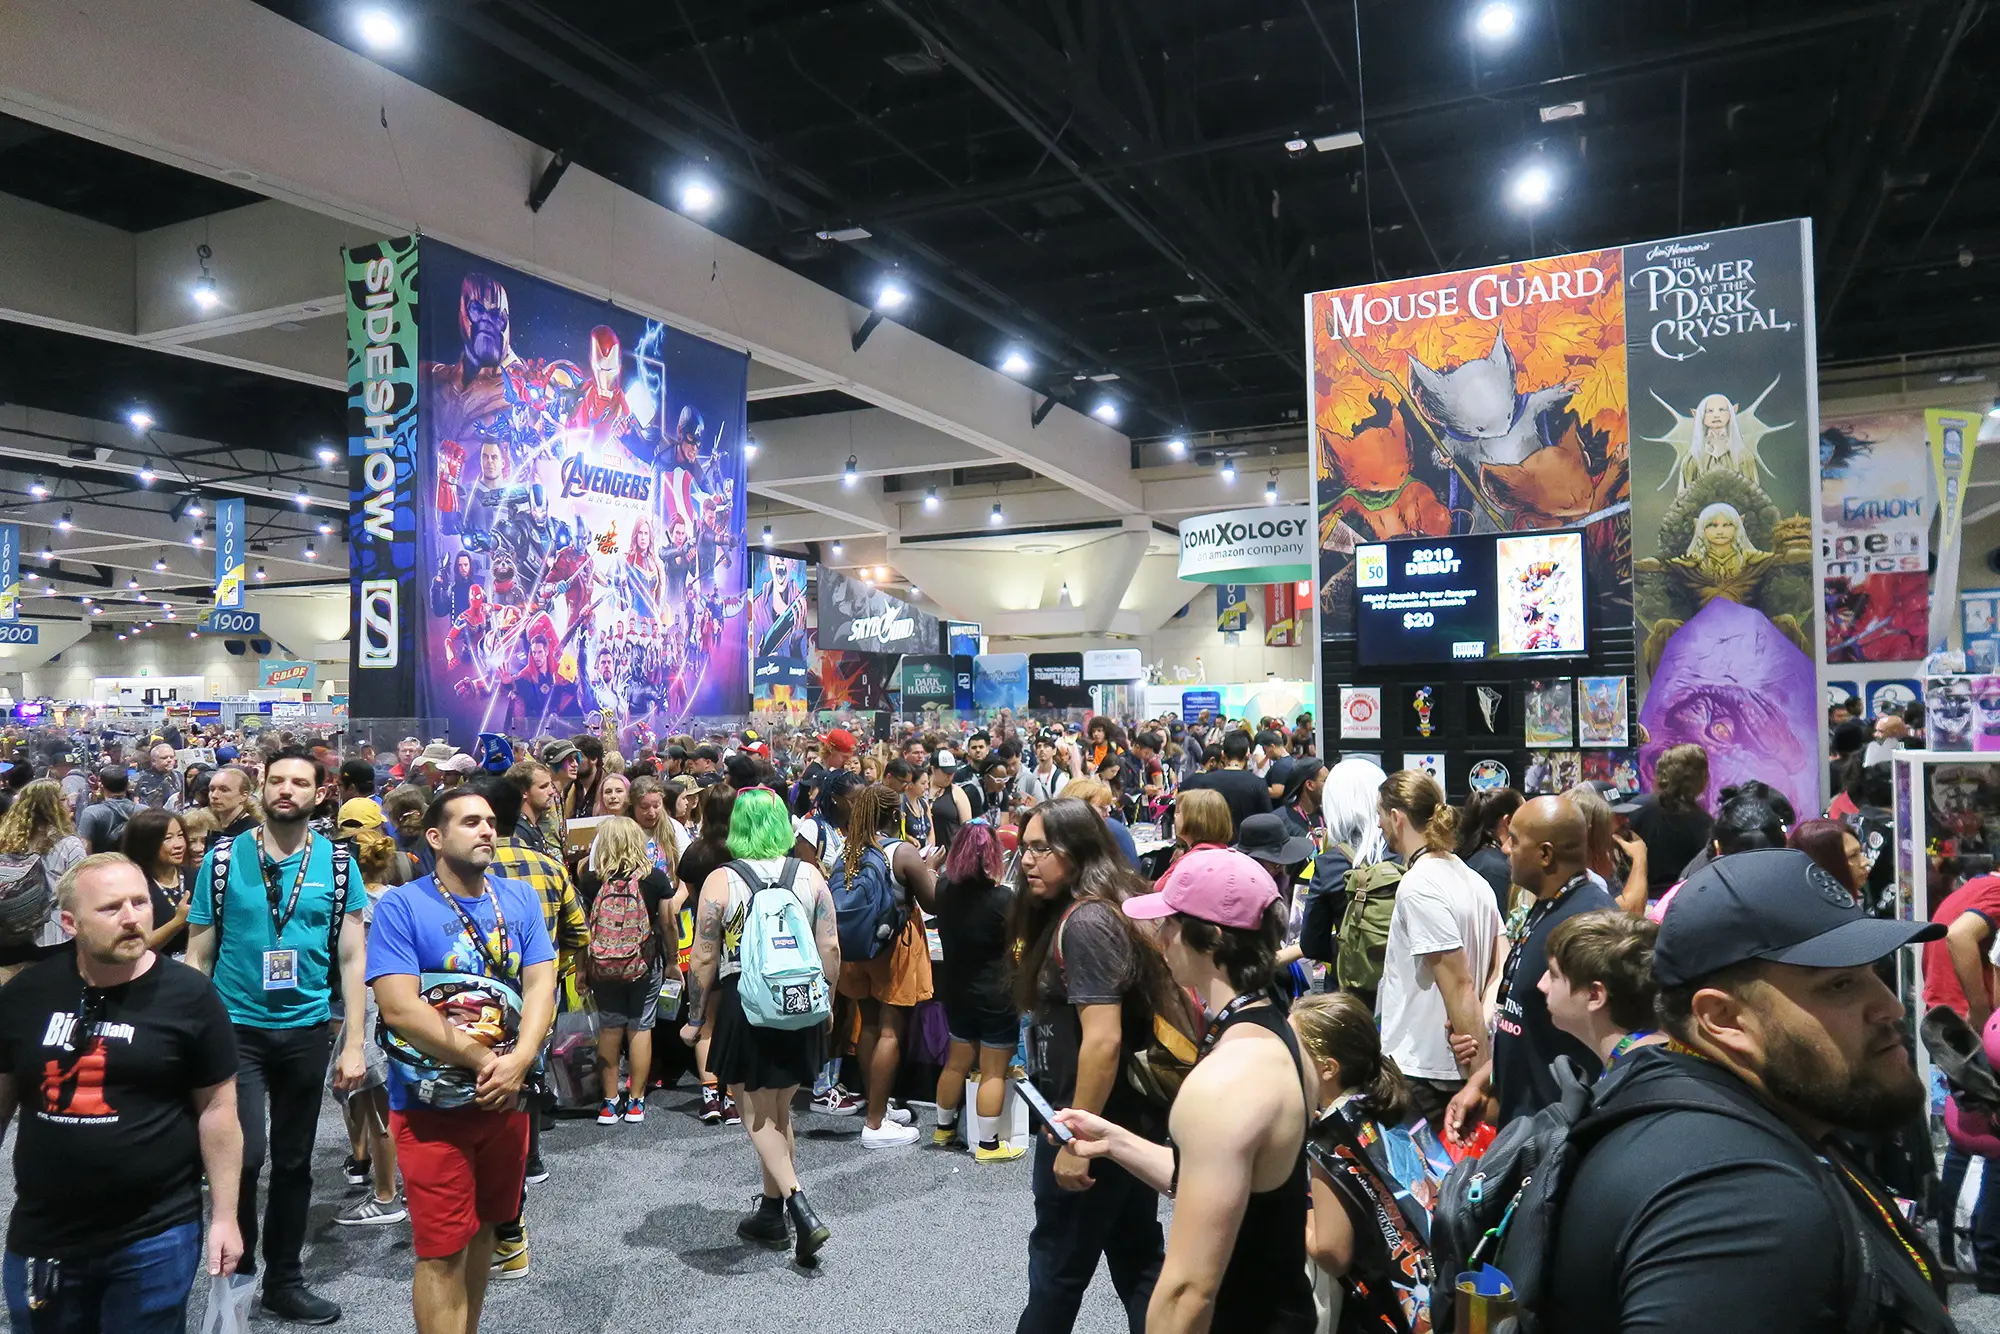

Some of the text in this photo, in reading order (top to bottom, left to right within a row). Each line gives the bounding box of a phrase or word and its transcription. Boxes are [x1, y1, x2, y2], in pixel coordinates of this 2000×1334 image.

[1669, 256, 1697, 269] THE
[1629, 259, 1757, 312] POWER
[1700, 280, 1749, 296] OF THE
[1329, 266, 1605, 341] MOUSE GUARD
[1663, 288, 1759, 321] DARK
[1650, 308, 1791, 361] CRYSTAL
[364, 257, 397, 541] SIDESHOW
[561, 451, 652, 502] AVENGERS
[1842, 497, 1925, 521] FATHOM
[224, 504, 234, 572] 1900
[1184, 518, 1308, 549] COMIXOLOGY
[2, 528, 11, 588] 1800
[1197, 543, 1304, 562] an amazon company
[1412, 547, 1454, 562] 2019
[1368, 565, 1384, 579] 50
[1405, 559, 1462, 576] DEBUT
[1419, 590, 1445, 600] Power
[1444, 589, 1478, 599] Rangers
[213, 613, 255, 631] 1900
[1403, 611, 1435, 630] $20
[915, 677, 940, 686] DARK
[1034, 672, 1080, 680] SOMETHING
[907, 685, 947, 695] HARVEST
[80, 1115, 119, 1124] PROGRAM
